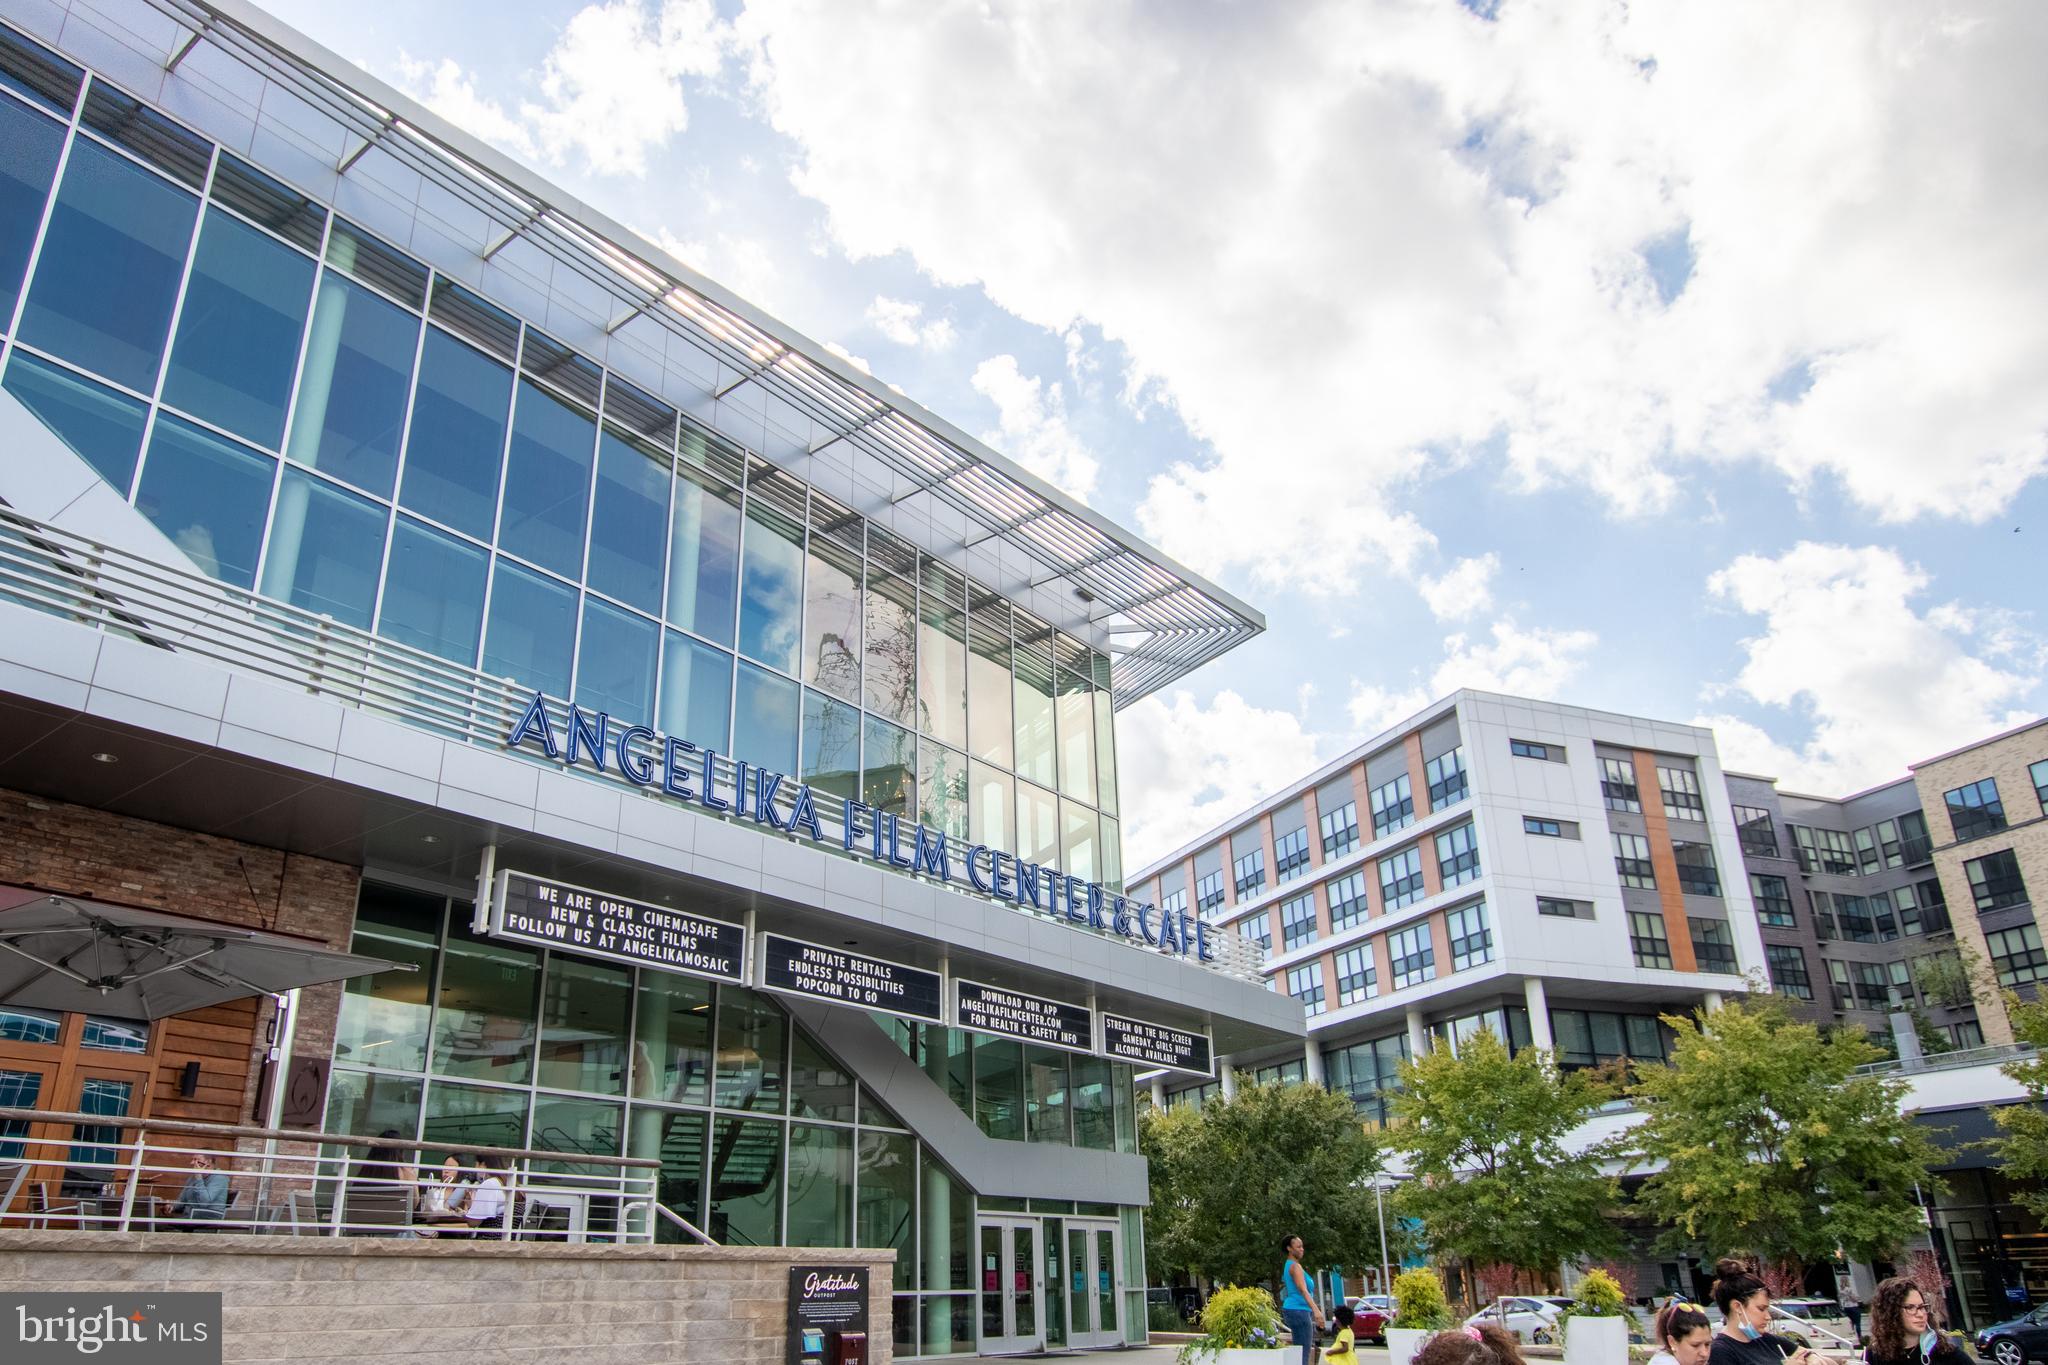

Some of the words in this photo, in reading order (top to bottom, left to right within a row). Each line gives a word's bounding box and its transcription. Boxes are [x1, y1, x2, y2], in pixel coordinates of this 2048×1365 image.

[508, 691, 823, 841] ANGELIKA
[844, 800, 951, 881] FILM
[966, 845, 1106, 928] CENTER
[1113, 897, 1133, 937] &
[1139, 903, 1214, 961] CAFE
[539, 885, 558, 903] WE
[566, 893, 592, 910] ARE
[600, 900, 633, 920] OPEN
[643, 911, 718, 939] CINEMASAFE
[509, 914, 566, 938] FOLLOW
[574, 928, 591, 944] US
[598, 934, 616, 949] AT
[622, 939, 729, 972] ANGELIKAMOSAIC
[551, 906, 579, 924] NEW
[586, 914, 595, 928] &
[602, 918, 655, 941] CLASSIC
[662, 931, 697, 950] FILMS
[788, 960, 832, 979] ENDLESS
[837, 971, 904, 995] POSSIBILITIES
[803, 948, 845, 968] PRIVATE
[851, 959, 892, 979] RENTALS
[796, 976, 842, 996] POPCORN
[848, 987, 860, 999] TO
[865, 991, 877, 1003] GO
[981, 990, 1022, 1008] DOWNLOAD
[1025, 1000, 1040, 1012] OUR
[1043, 1004, 1057, 1016] APP
[961, 998, 1062, 1029] ANGELIKAFILMCENTER.COM
[971, 1013, 986, 1026] FOR
[990, 1017, 1019, 1033] HEALTH
[1022, 1025, 1027, 1034] &
[1031, 1026, 1058, 1040] SAFETY
[1061, 1031, 1077, 1044] INFO
[1106, 1018, 1131, 1032] STREAM
[1134, 1024, 1142, 1034] ON
[1145, 1027, 1156, 1037] THE
[1159, 1030, 1169, 1040] BIG
[1171, 1033, 1192, 1046] SCREEN
[1115, 1043, 1142, 1057] ALCOHOL
[1145, 1050, 1178, 1064] AVAILABLE
[1155, 1041, 1173, 1052] GIRLS
[1175, 1045, 1191, 1056] NIGHT
[803, 1272, 859, 1298] Gratitude
